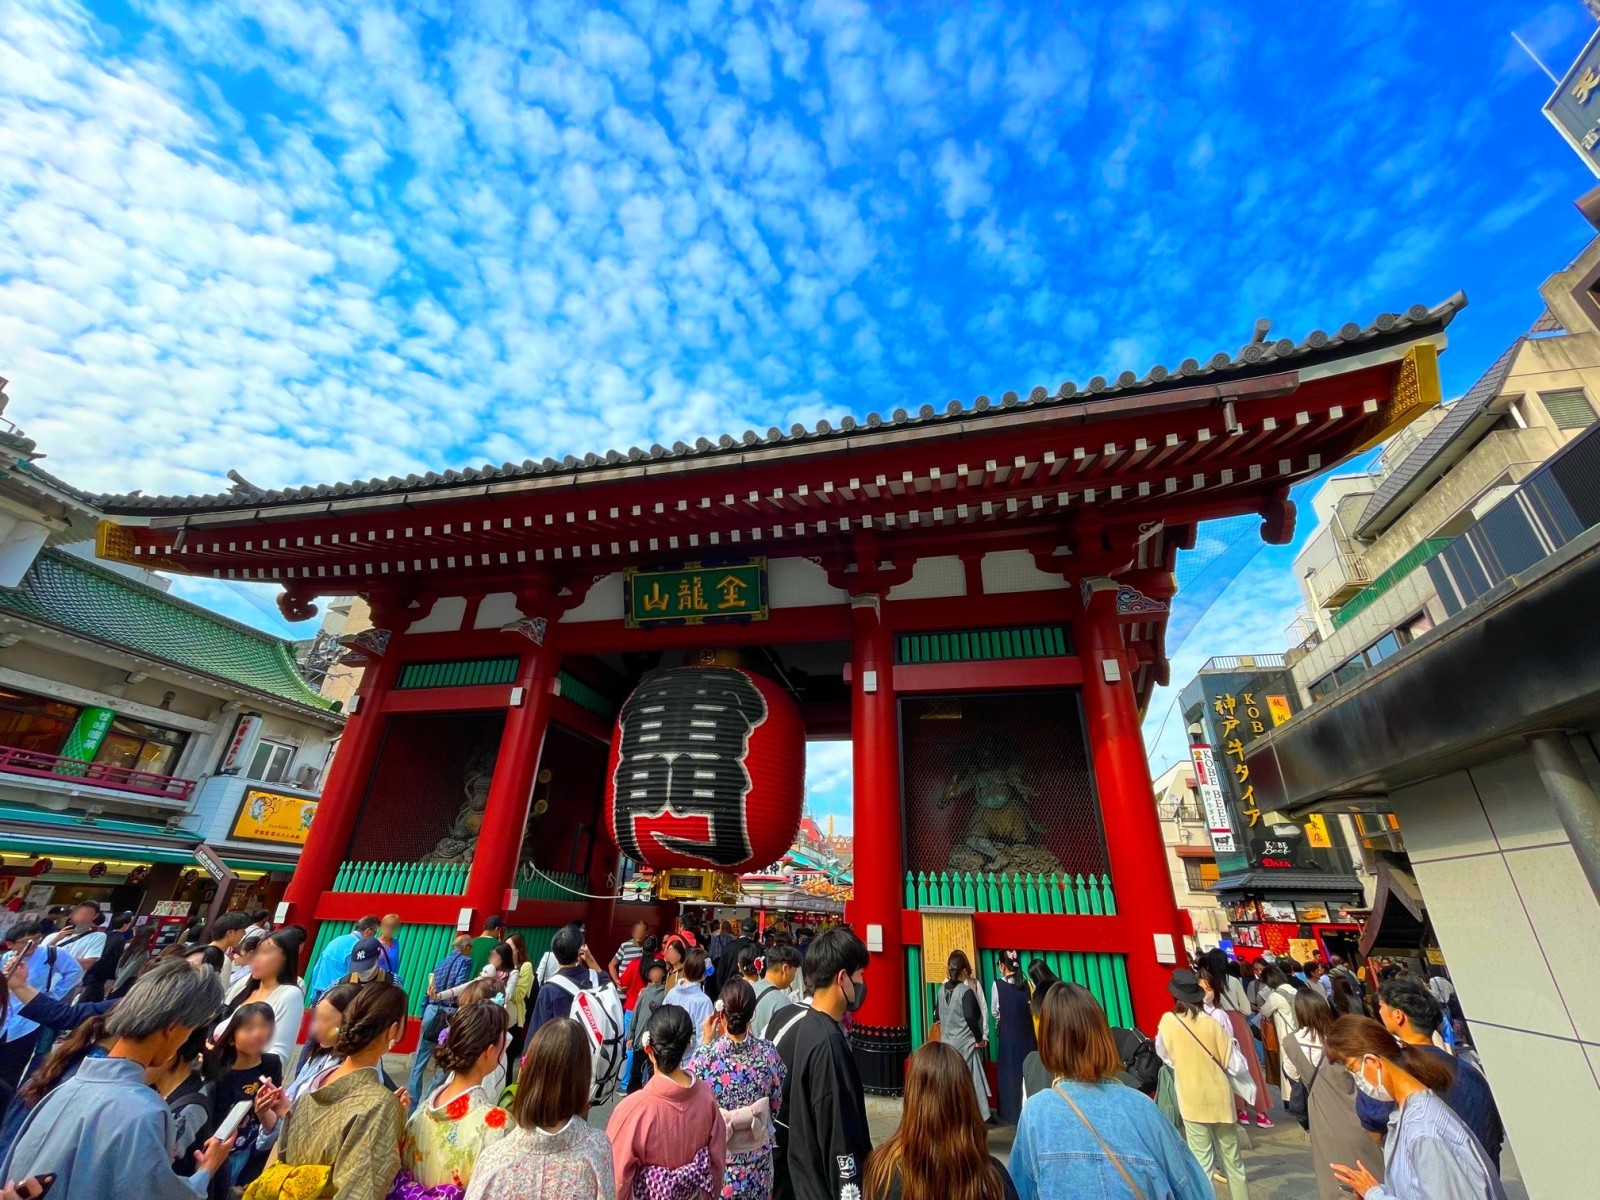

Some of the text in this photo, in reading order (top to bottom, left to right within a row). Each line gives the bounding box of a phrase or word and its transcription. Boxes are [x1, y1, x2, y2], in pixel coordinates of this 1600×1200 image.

[1243, 693, 1264, 739] KOB
[1203, 750, 1227, 827] KOBE BEEF
